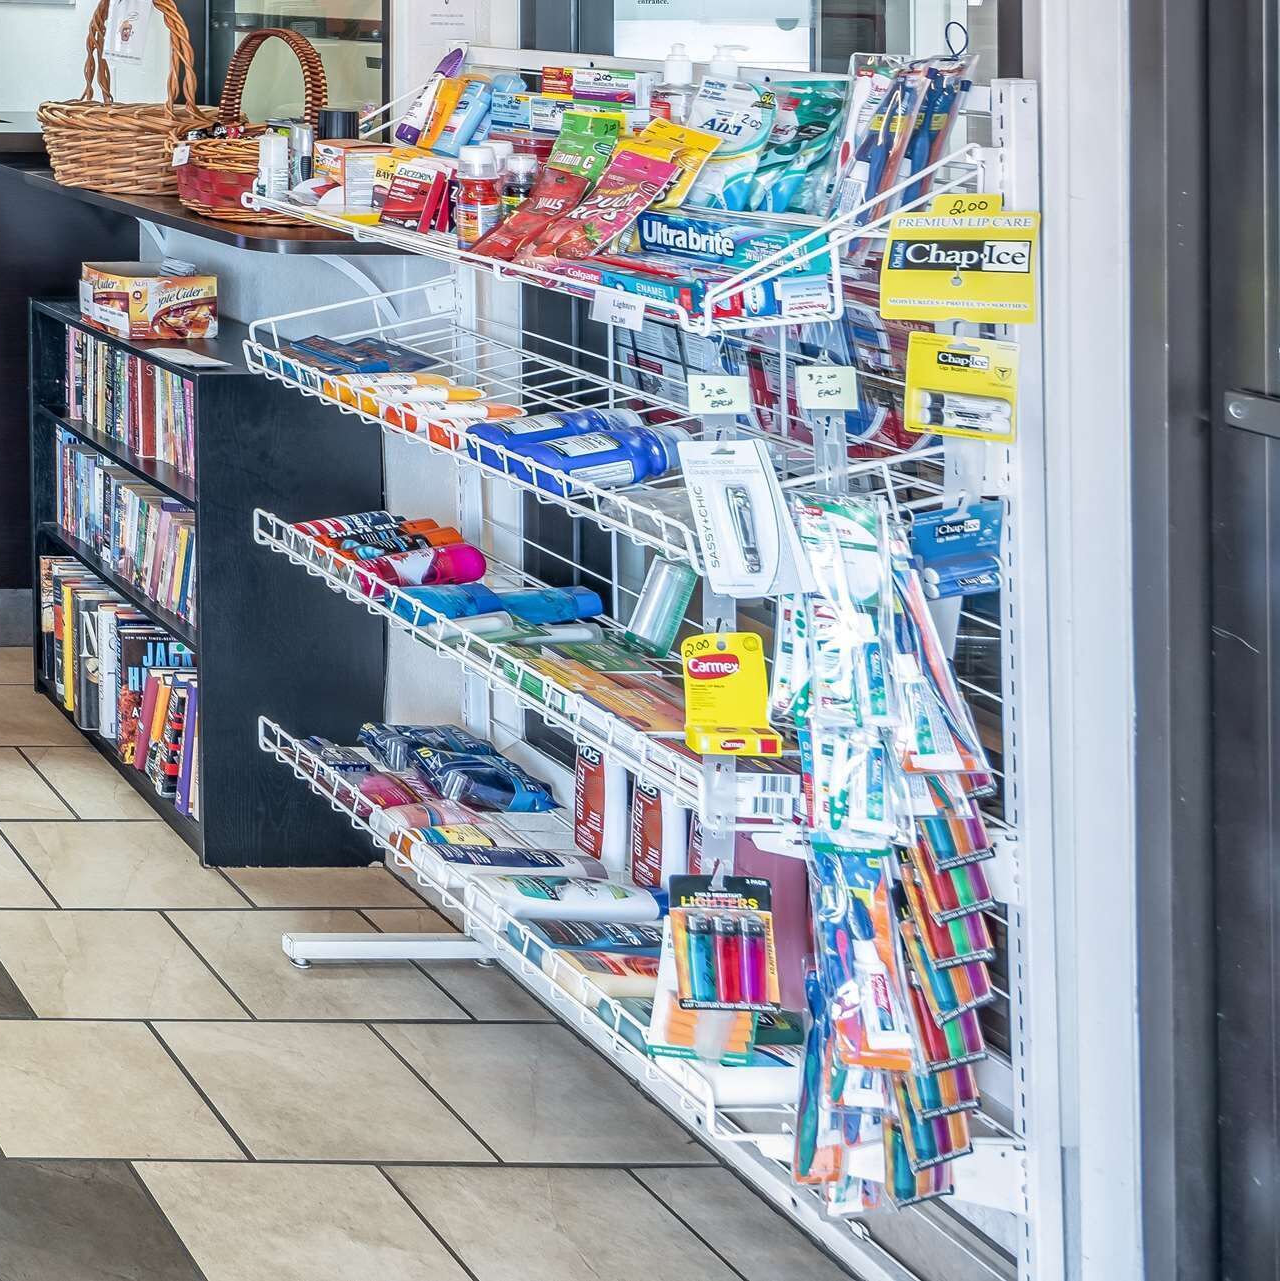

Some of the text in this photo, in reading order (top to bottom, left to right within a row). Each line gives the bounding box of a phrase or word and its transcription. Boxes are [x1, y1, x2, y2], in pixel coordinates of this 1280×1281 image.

[398, 167, 434, 182] EXCEDRIN
[949, 200, 988, 215] 2.00
[897, 217, 1032, 227] PREMIUM LIP CARE
[642, 219, 735, 257] Ultrabrite
[568, 267, 601, 282] Colgate
[176, 287, 203, 299] Cider
[636, 282, 668, 299] ENAMEL
[613, 299, 637, 311] Lighters
[818, 388, 841, 398] EACH
[711, 400, 734, 408] EACH
[328, 521, 400, 538] SHAVE GEL
[688, 658, 740, 673] Carmex
[576, 764, 586, 820] anti-frizz
[633, 800, 644, 857] anti-frizz
[681, 896, 759, 910] LIGHTERS
